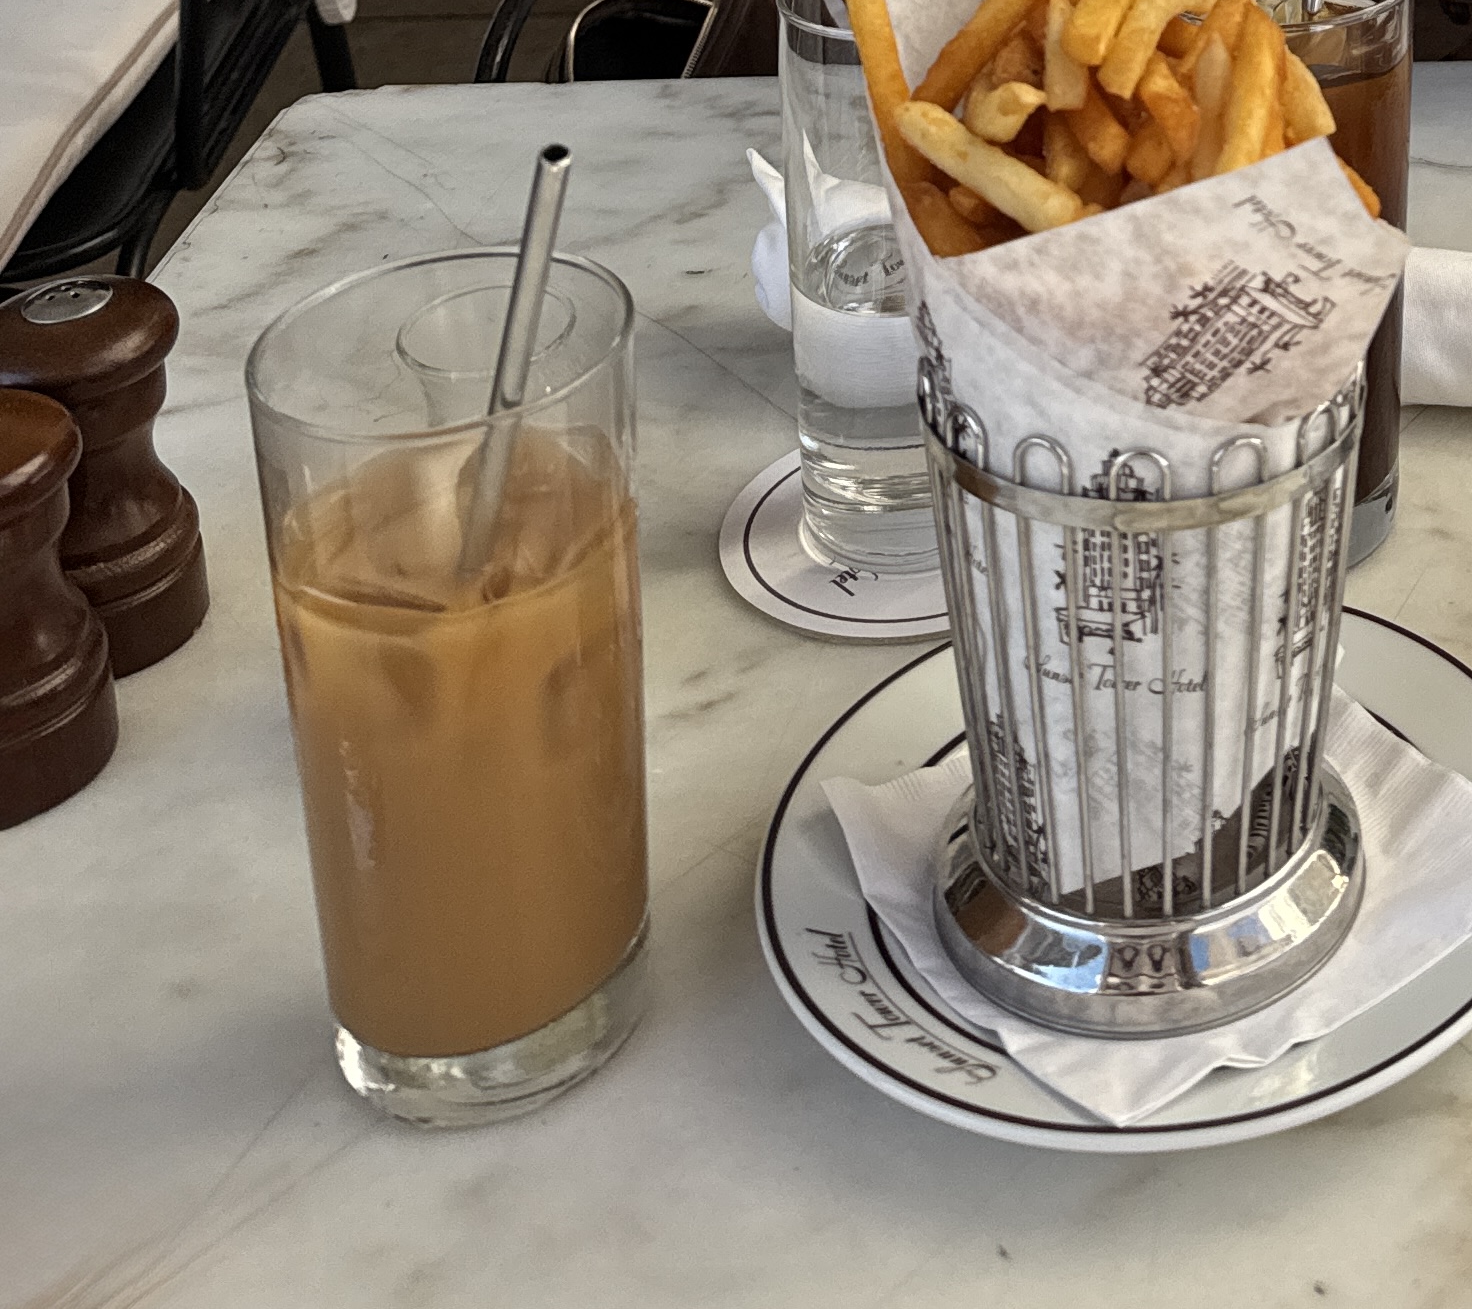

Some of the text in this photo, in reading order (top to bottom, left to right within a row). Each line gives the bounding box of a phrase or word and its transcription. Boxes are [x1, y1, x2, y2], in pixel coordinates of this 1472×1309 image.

[805, 927, 997, 1085] Sunset Tower Hotel
